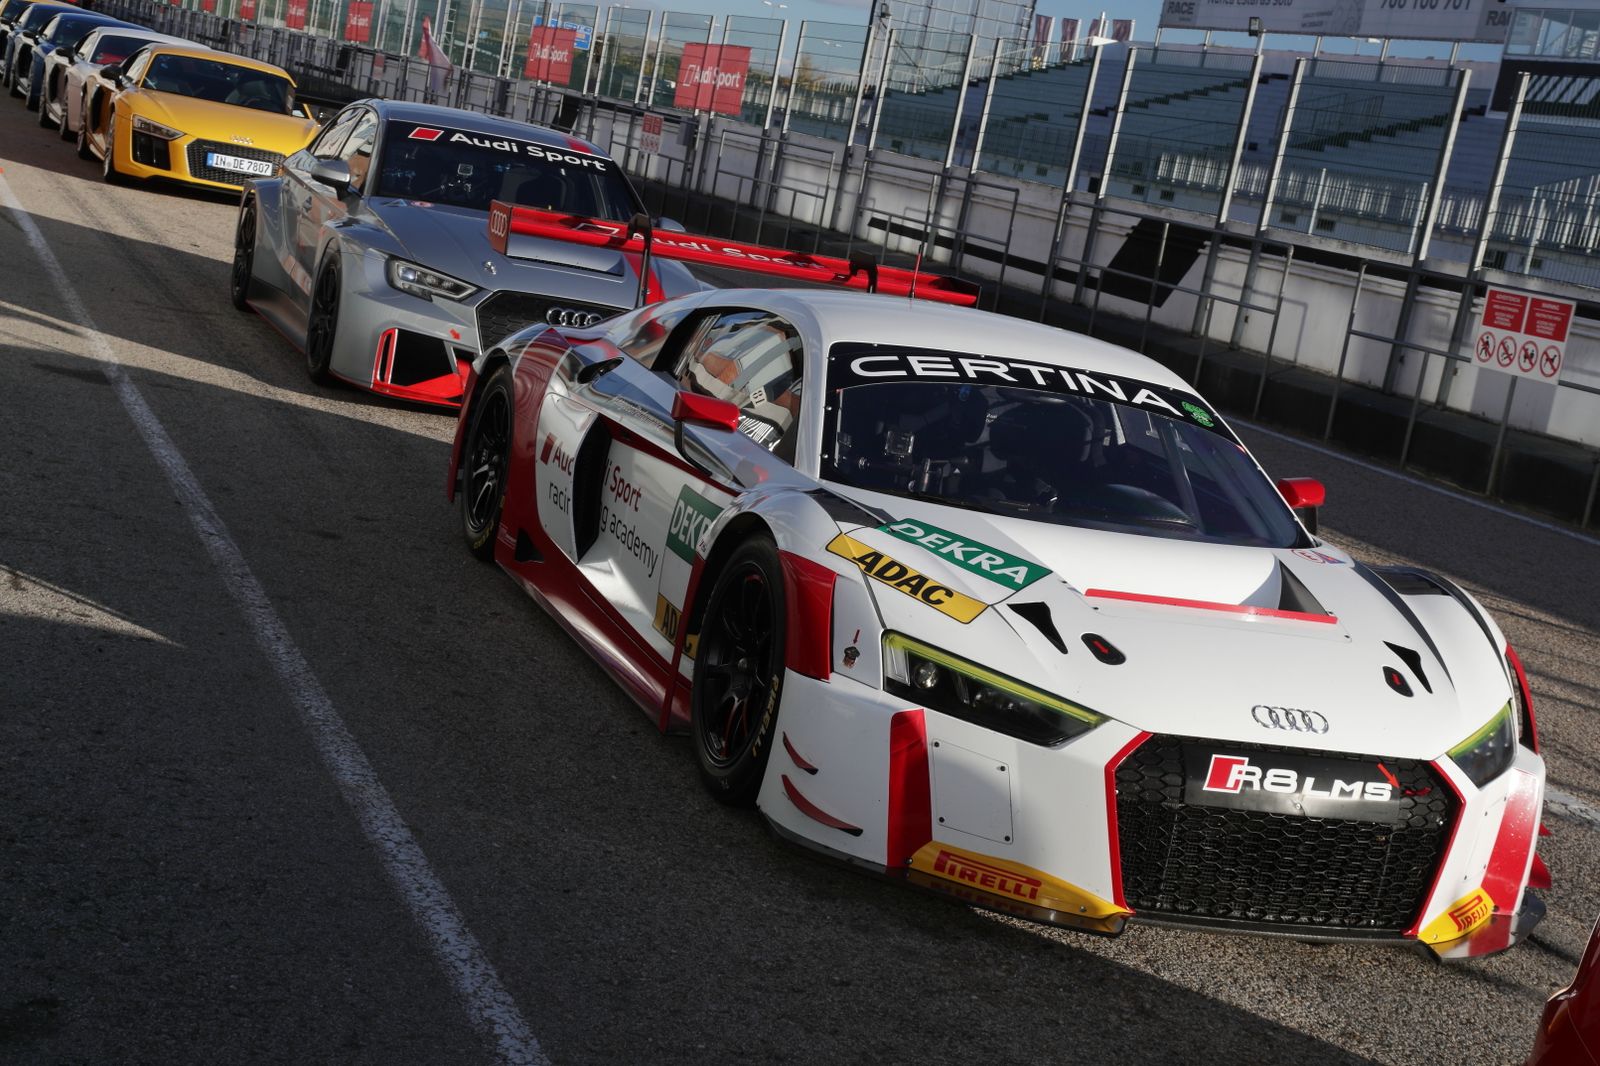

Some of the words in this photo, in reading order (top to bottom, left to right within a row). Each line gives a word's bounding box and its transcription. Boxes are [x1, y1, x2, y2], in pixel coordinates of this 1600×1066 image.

[1167, 2, 1196, 15] RACE
[693, 64, 713, 84] Audi
[712, 66, 741, 90] Sport
[215, 155, 227, 167] IN
[233, 158, 245, 170] DE
[247, 161, 270, 174] 7807
[450, 133, 519, 153] Audi
[526, 146, 607, 172] Sport
[850, 355, 1185, 417] CERTINA
[610, 465, 642, 512] Sport
[609, 513, 659, 578] academy
[894, 523, 1029, 585] DEKRA
[852, 551, 954, 606] ADAC
[1226, 764, 1298, 794] R8
[1302, 776, 1393, 802] LMS
[934, 849, 1042, 900] PIRELLI
[1448, 895, 1488, 933] PIRELLI
